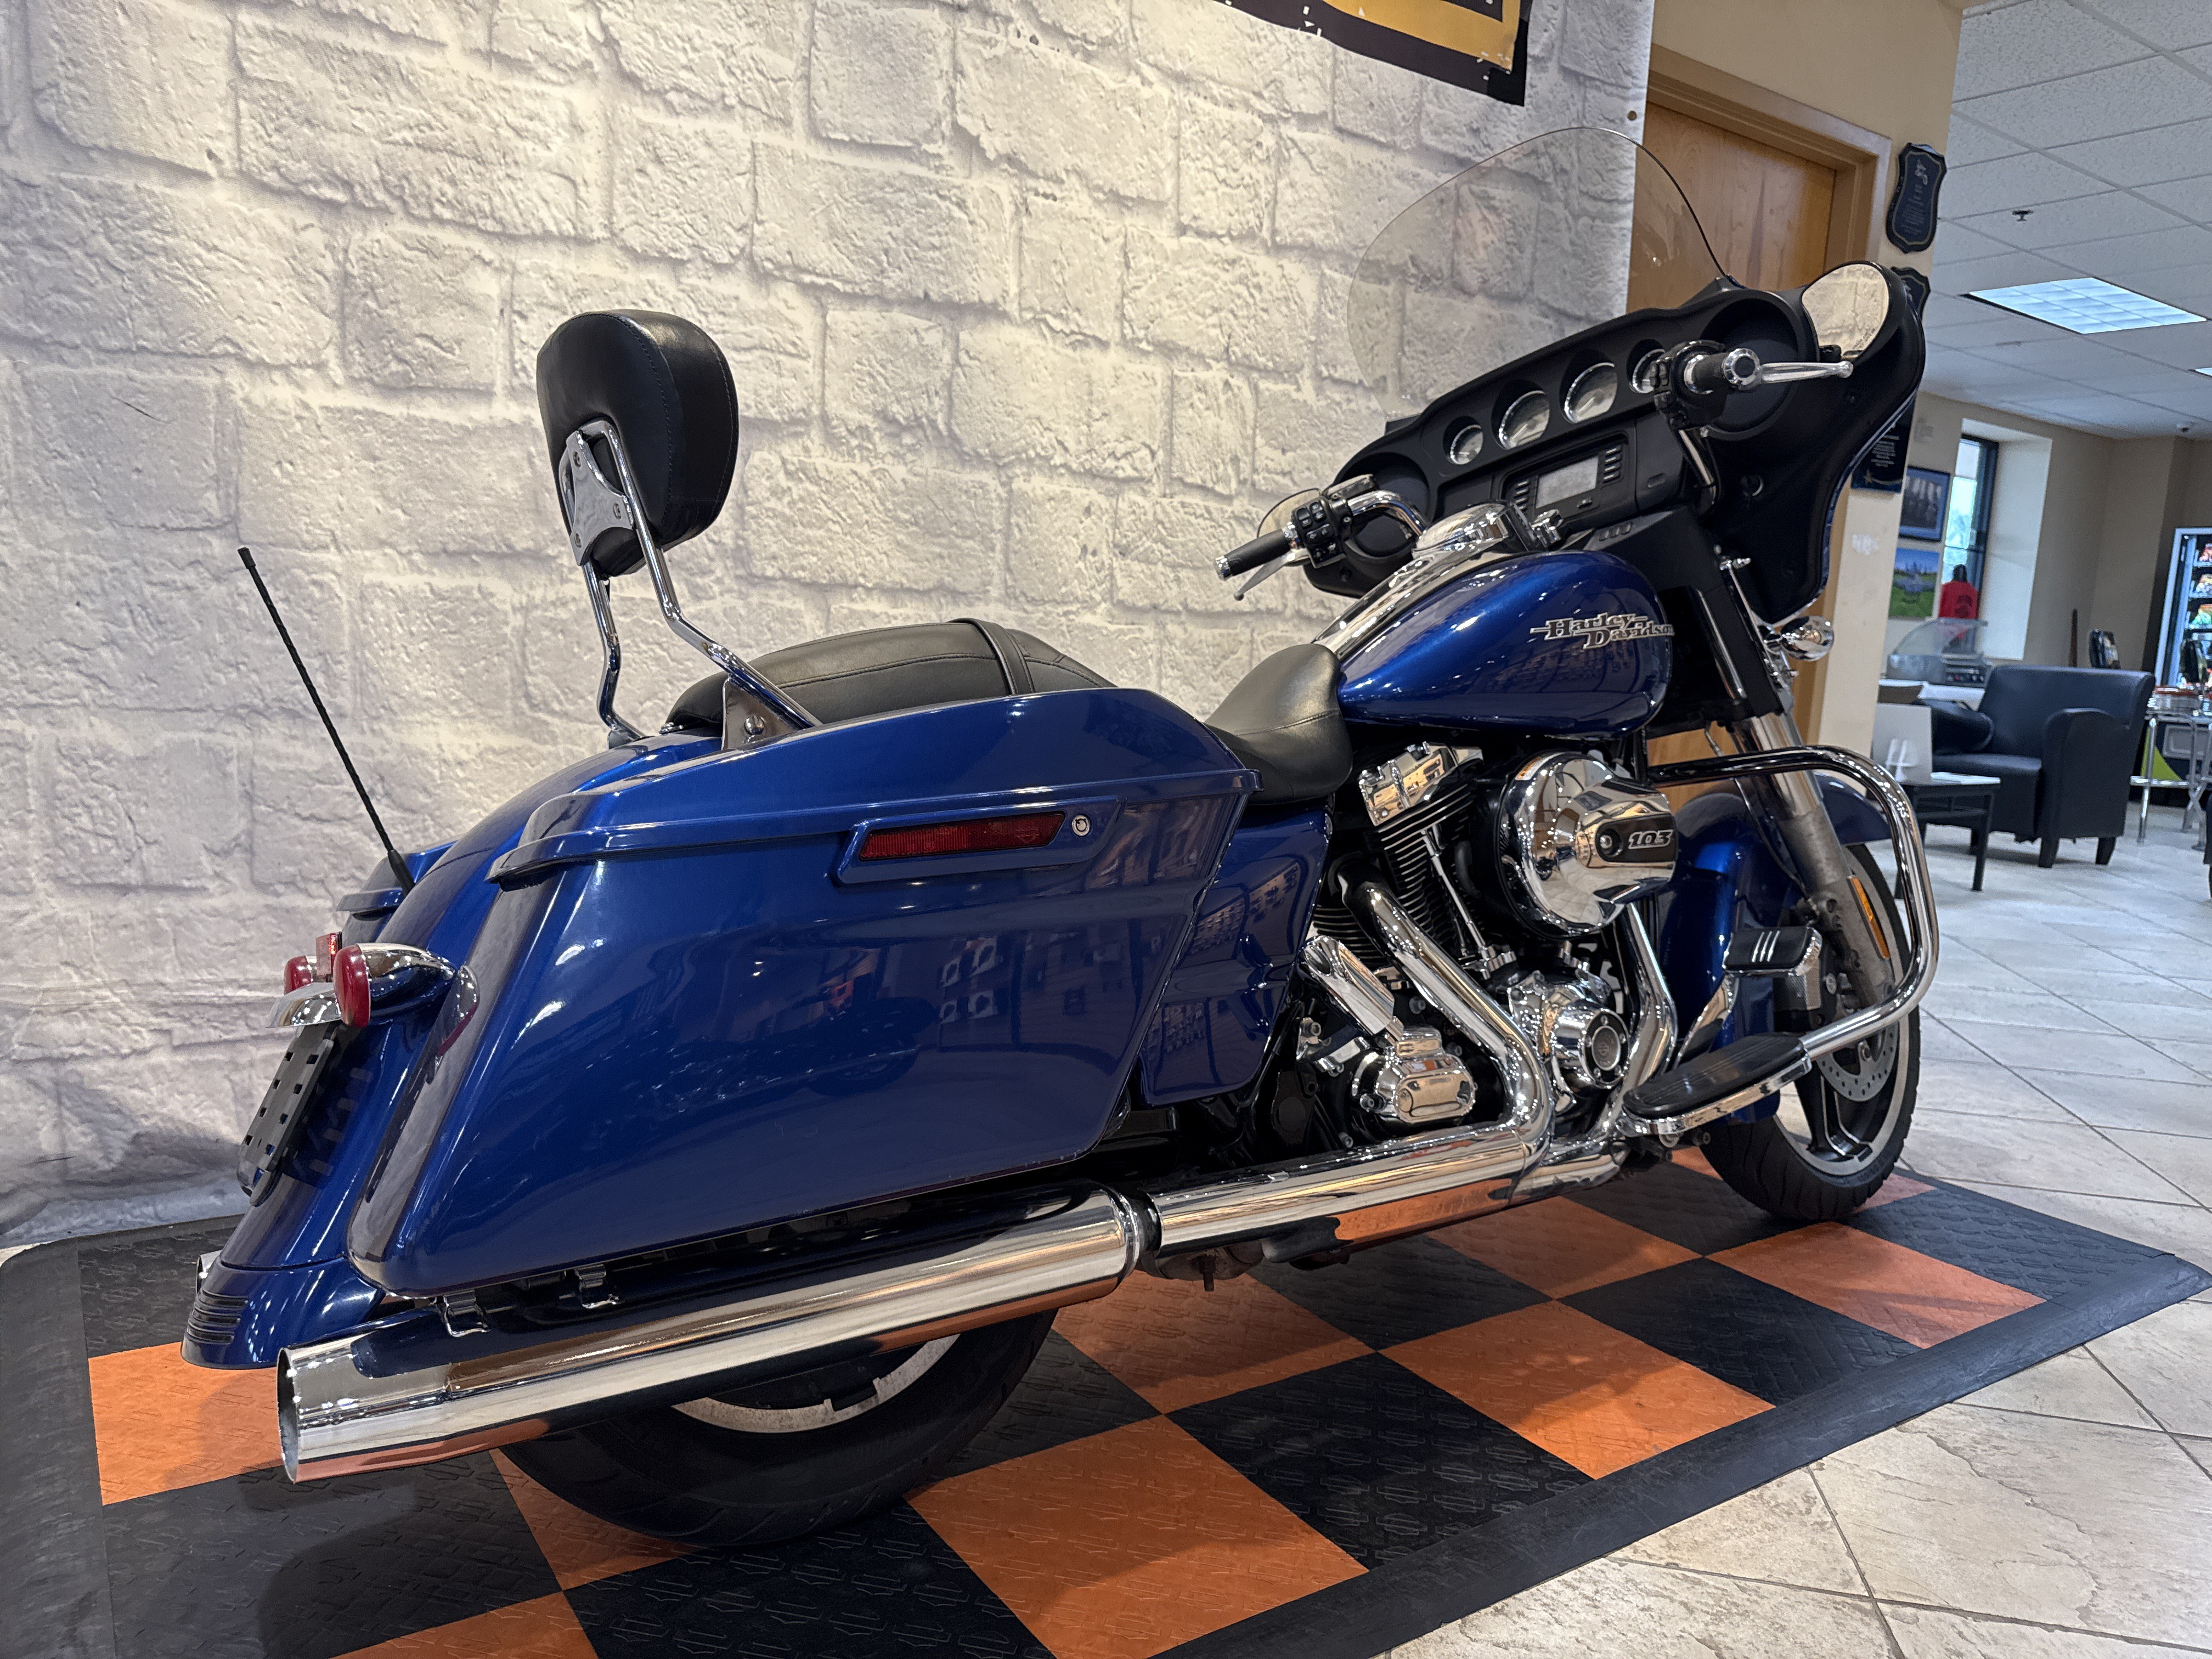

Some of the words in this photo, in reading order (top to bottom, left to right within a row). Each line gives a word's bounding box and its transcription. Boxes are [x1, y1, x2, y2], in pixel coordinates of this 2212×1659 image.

[1530, 612, 1647, 640] Harley
[1573, 620, 1675, 650] Davidson
[1628, 829, 1674, 850] 103
